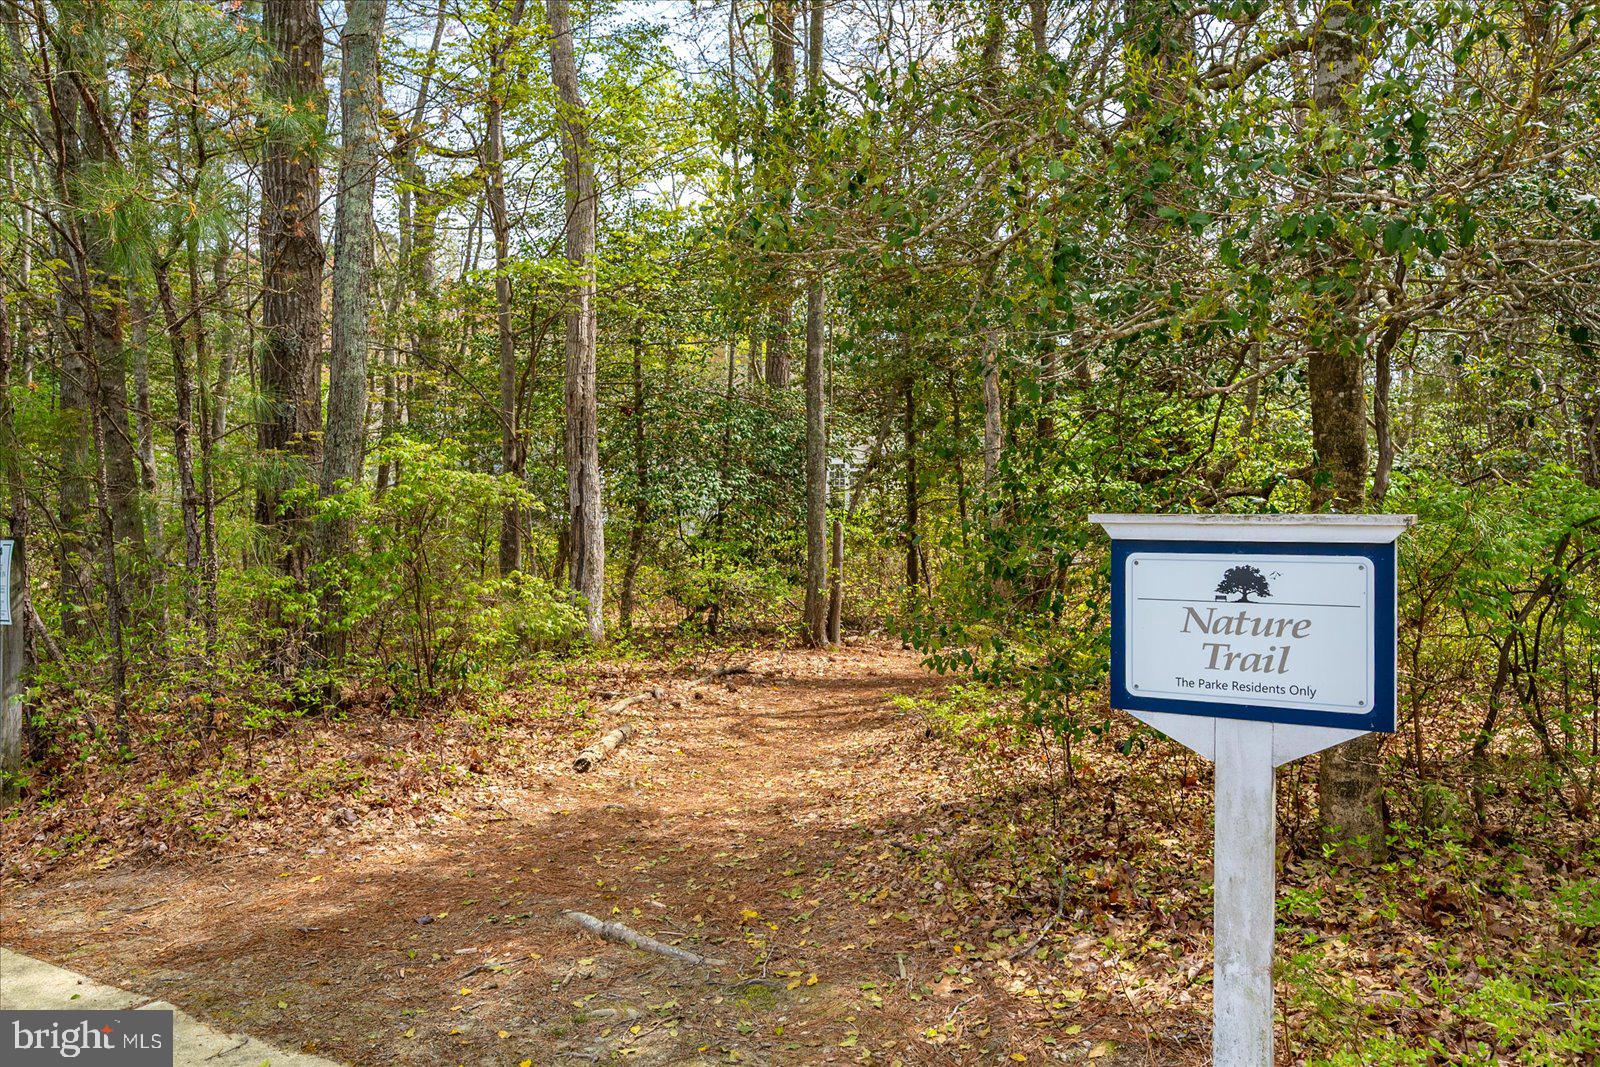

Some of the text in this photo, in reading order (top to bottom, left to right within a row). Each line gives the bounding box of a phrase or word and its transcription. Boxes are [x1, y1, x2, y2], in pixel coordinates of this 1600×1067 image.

[1180, 606, 1312, 639] Nature
[1202, 642, 1291, 674] Trail
[1175, 677, 1317, 699] The Parke Residents Only
